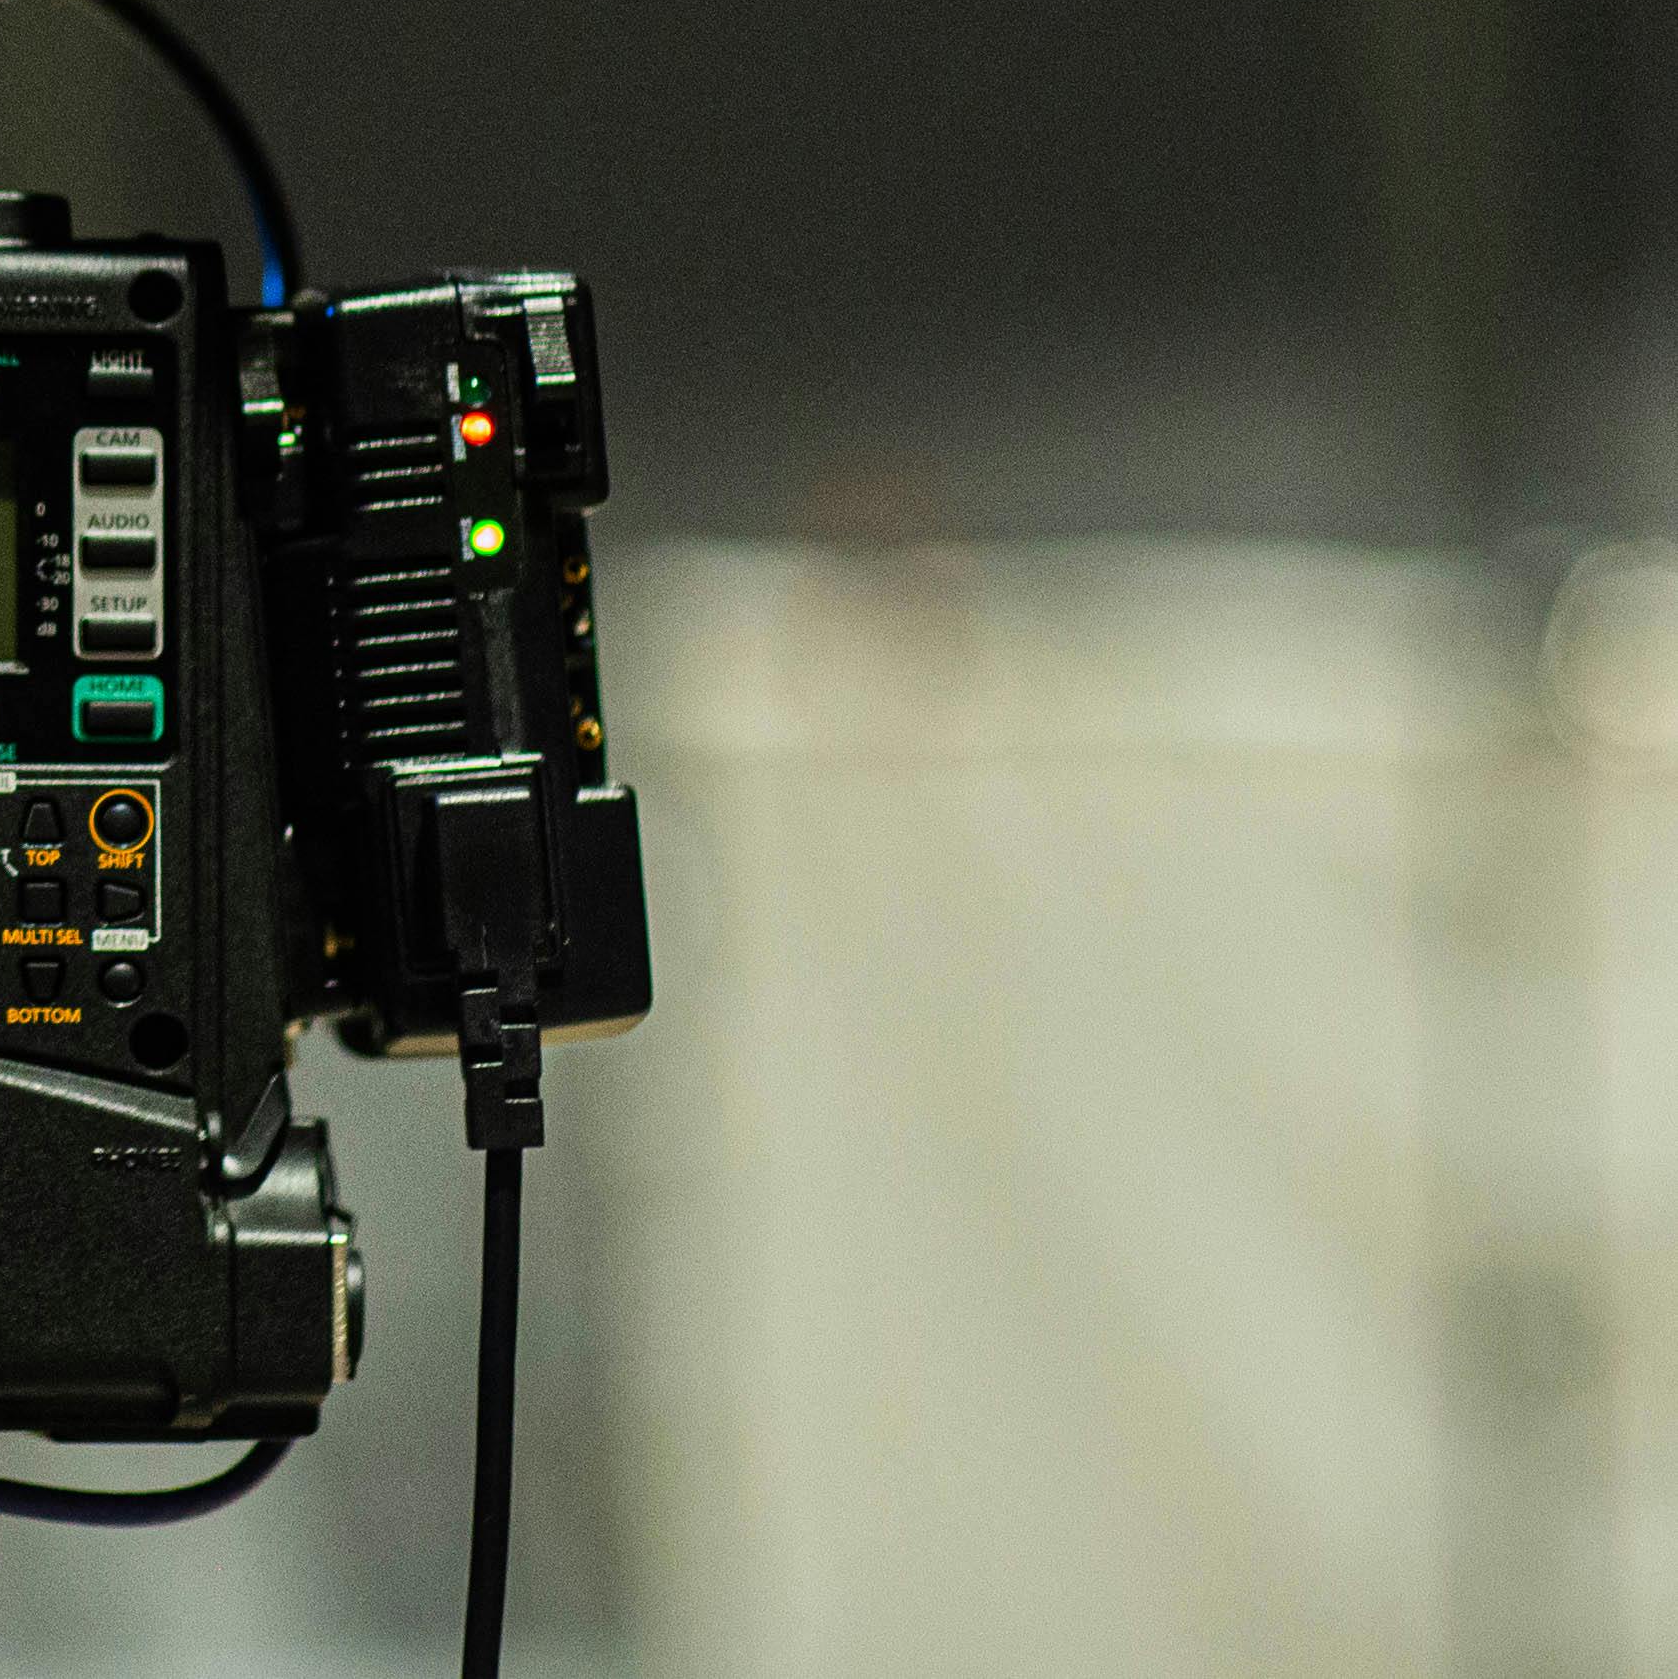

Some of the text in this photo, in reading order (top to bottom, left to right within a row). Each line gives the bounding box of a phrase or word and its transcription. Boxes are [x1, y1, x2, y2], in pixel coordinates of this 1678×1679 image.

[92, 350, 144, 373] LIGHT
[96, 432, 141, 447] CAM
[88, 513, 150, 530] AUDIO
[90, 594, 148, 612] SETUP
[26, 849, 61, 866] TOP
[97, 852, 147, 870] SHIFT
[2, 928, 84, 946] MULTI SEL
[6, 1007, 82, 1024] BOTTOM
